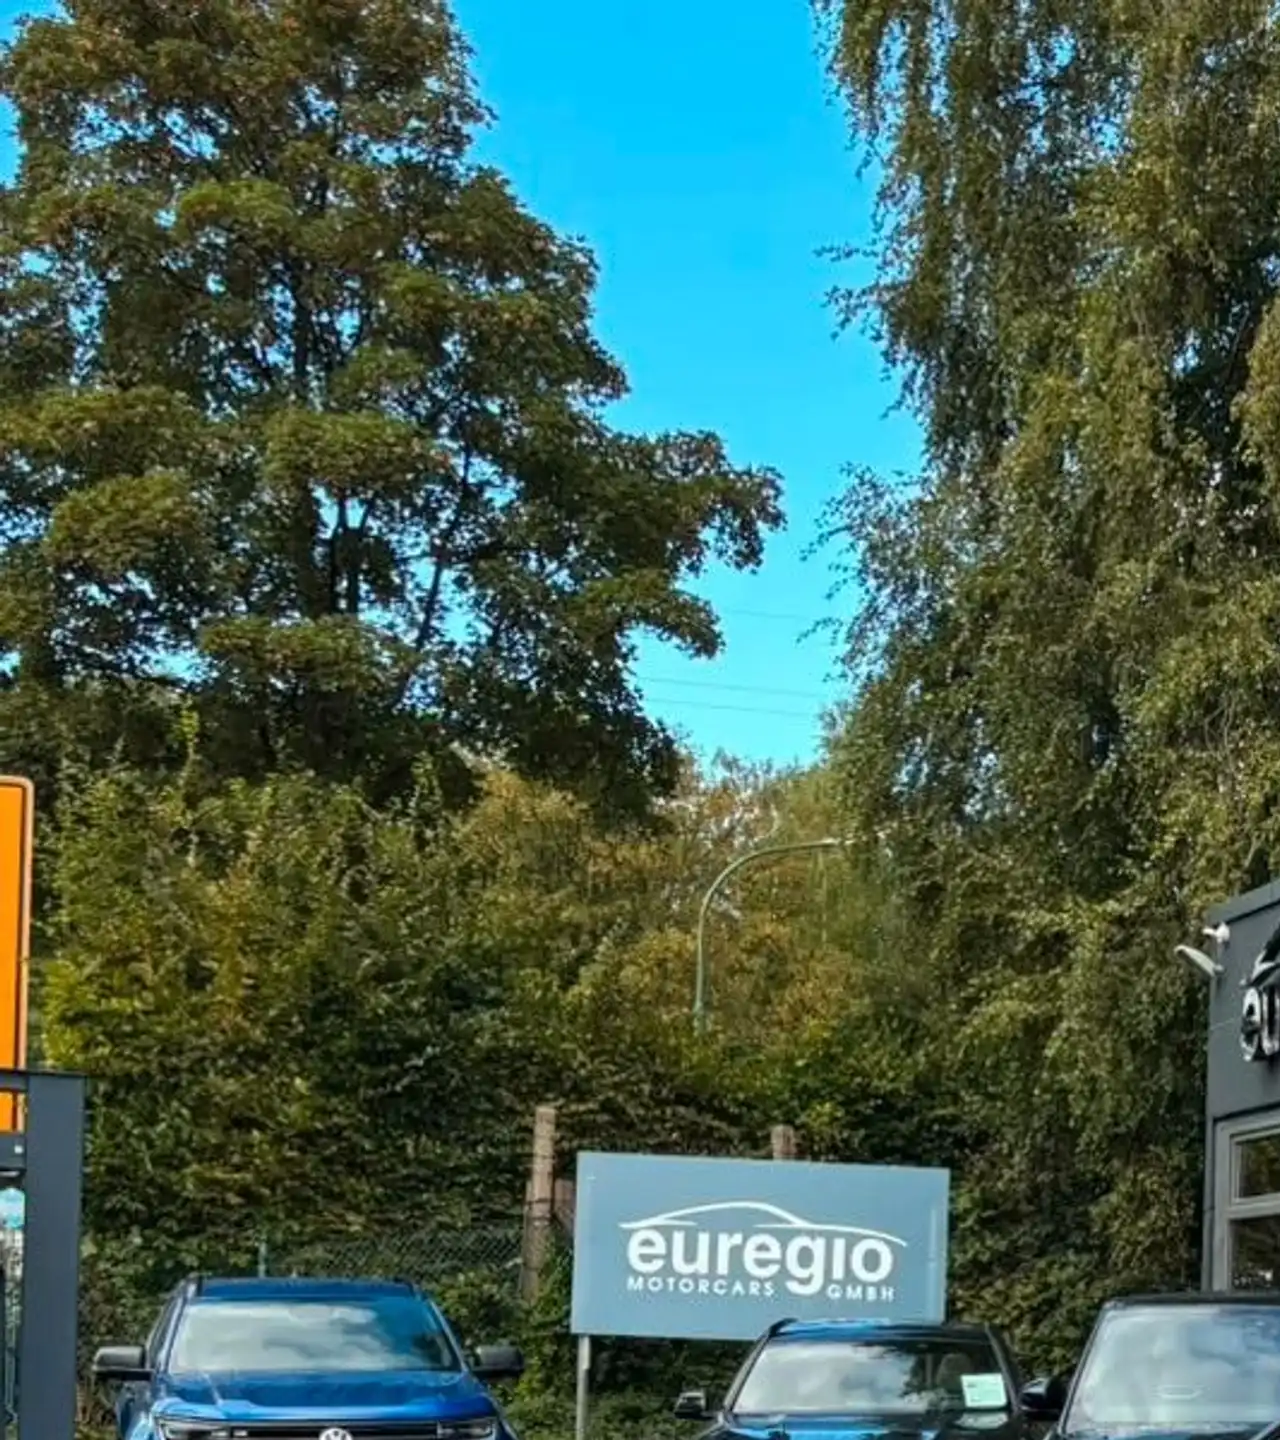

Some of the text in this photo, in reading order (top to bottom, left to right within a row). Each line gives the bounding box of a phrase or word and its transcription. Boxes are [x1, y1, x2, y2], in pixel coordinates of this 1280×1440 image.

[627, 1228, 894, 1296] euregio
[627, 1275, 895, 1302] MOTORCARS GMBH
